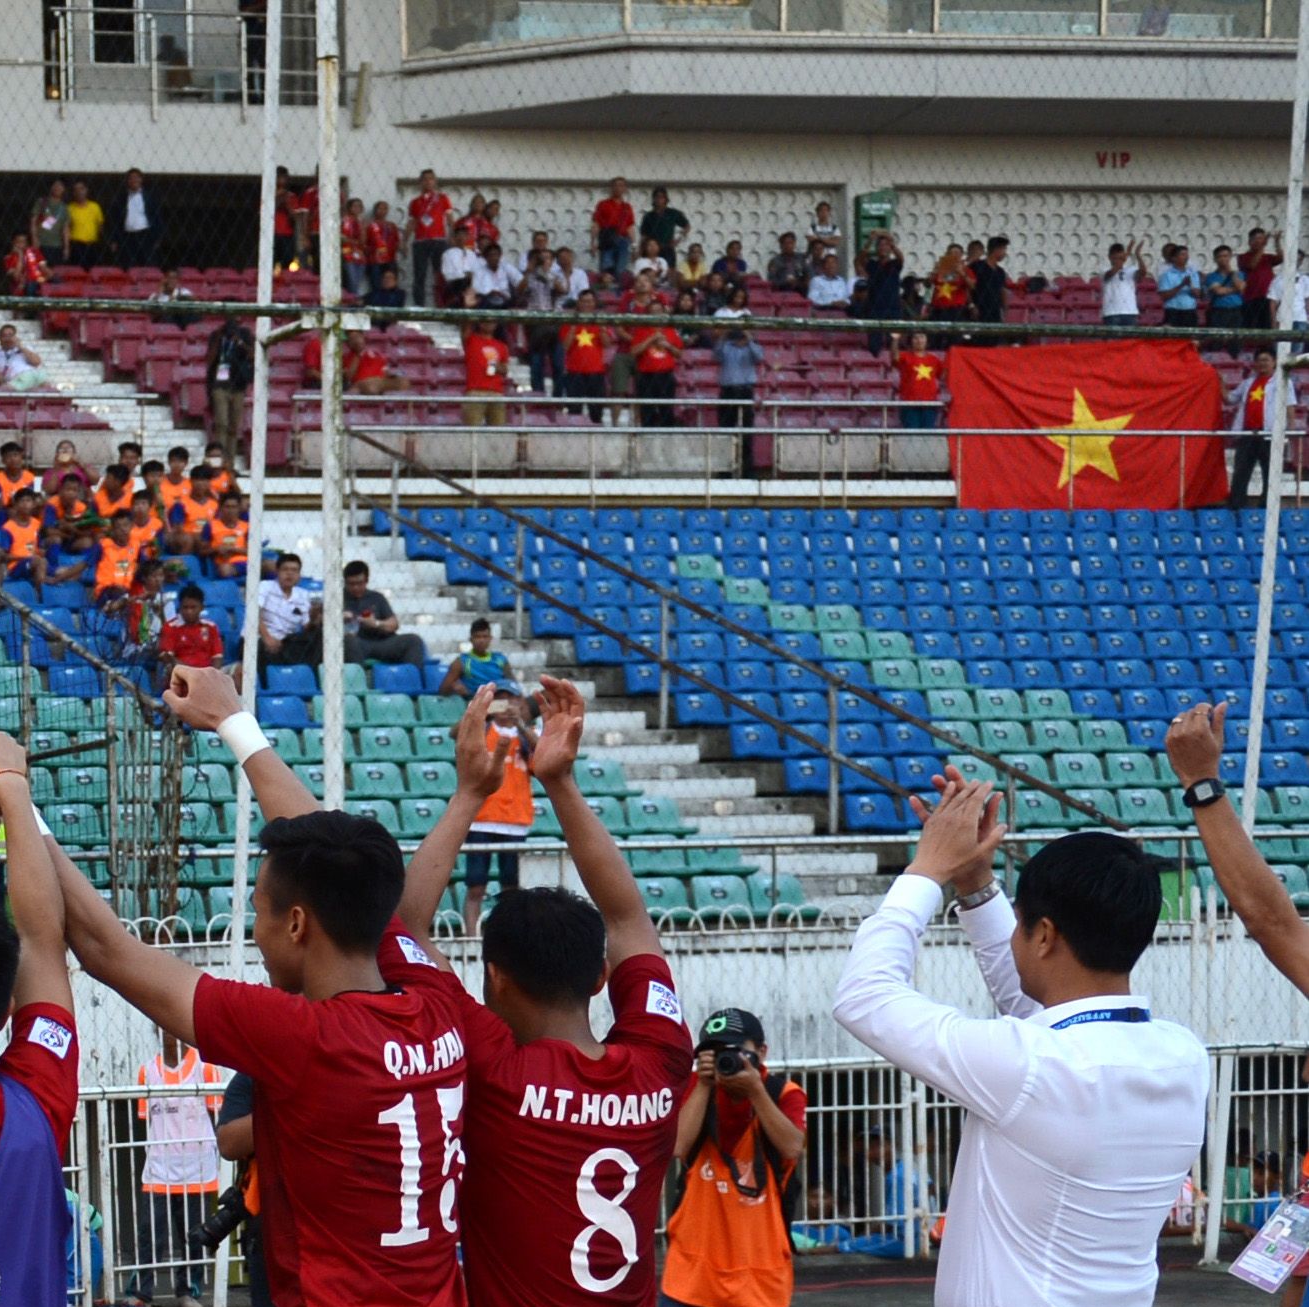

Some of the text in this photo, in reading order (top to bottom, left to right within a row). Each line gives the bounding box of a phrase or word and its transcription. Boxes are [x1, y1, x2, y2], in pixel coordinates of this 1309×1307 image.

[1096, 152, 1131, 168] VIP
[518, 1084, 673, 1127] N.T.HOANG
[570, 1147, 640, 1293] 8
